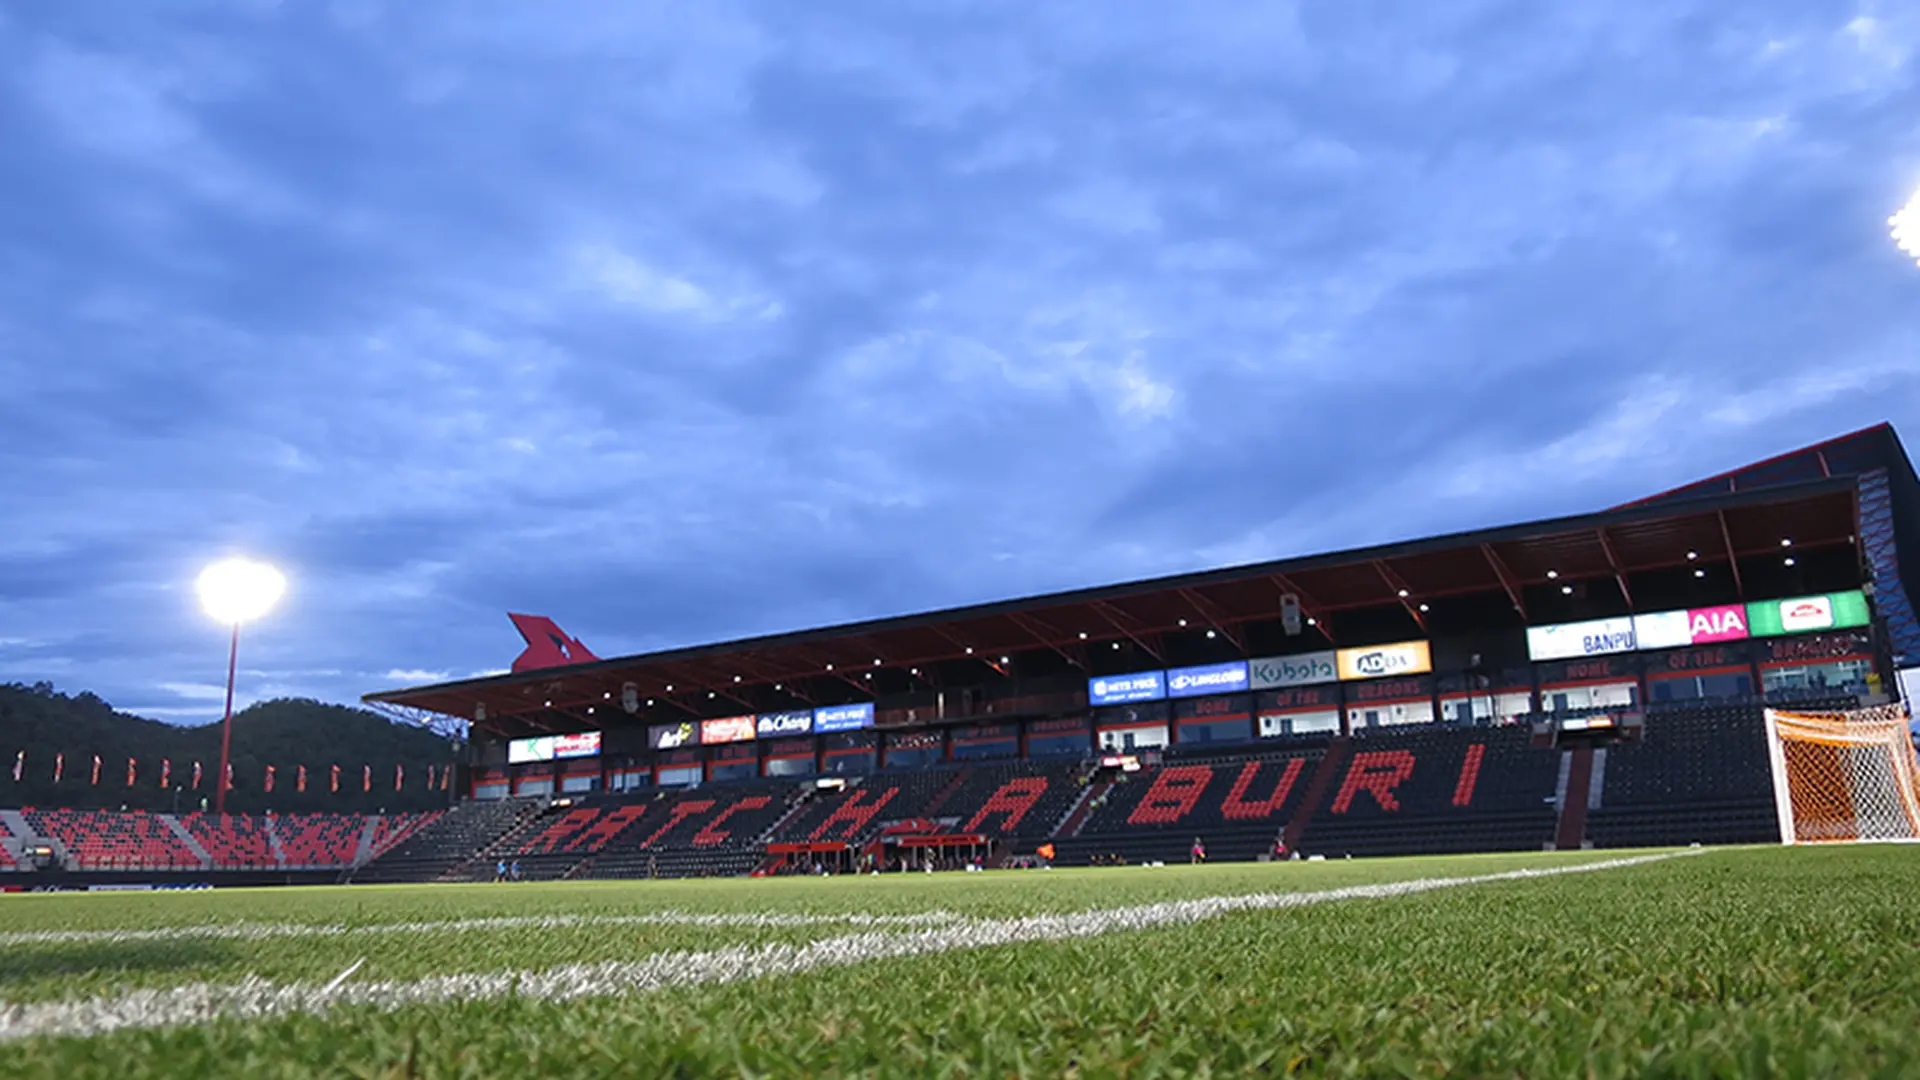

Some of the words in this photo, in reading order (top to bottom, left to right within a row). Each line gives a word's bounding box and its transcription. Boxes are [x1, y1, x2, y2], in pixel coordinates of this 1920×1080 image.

[1691, 611, 1744, 635] AIA
[1583, 631, 1635, 653] BANPU
[1254, 659, 1332, 683] Kubota
[773, 713, 811, 732] Chang
